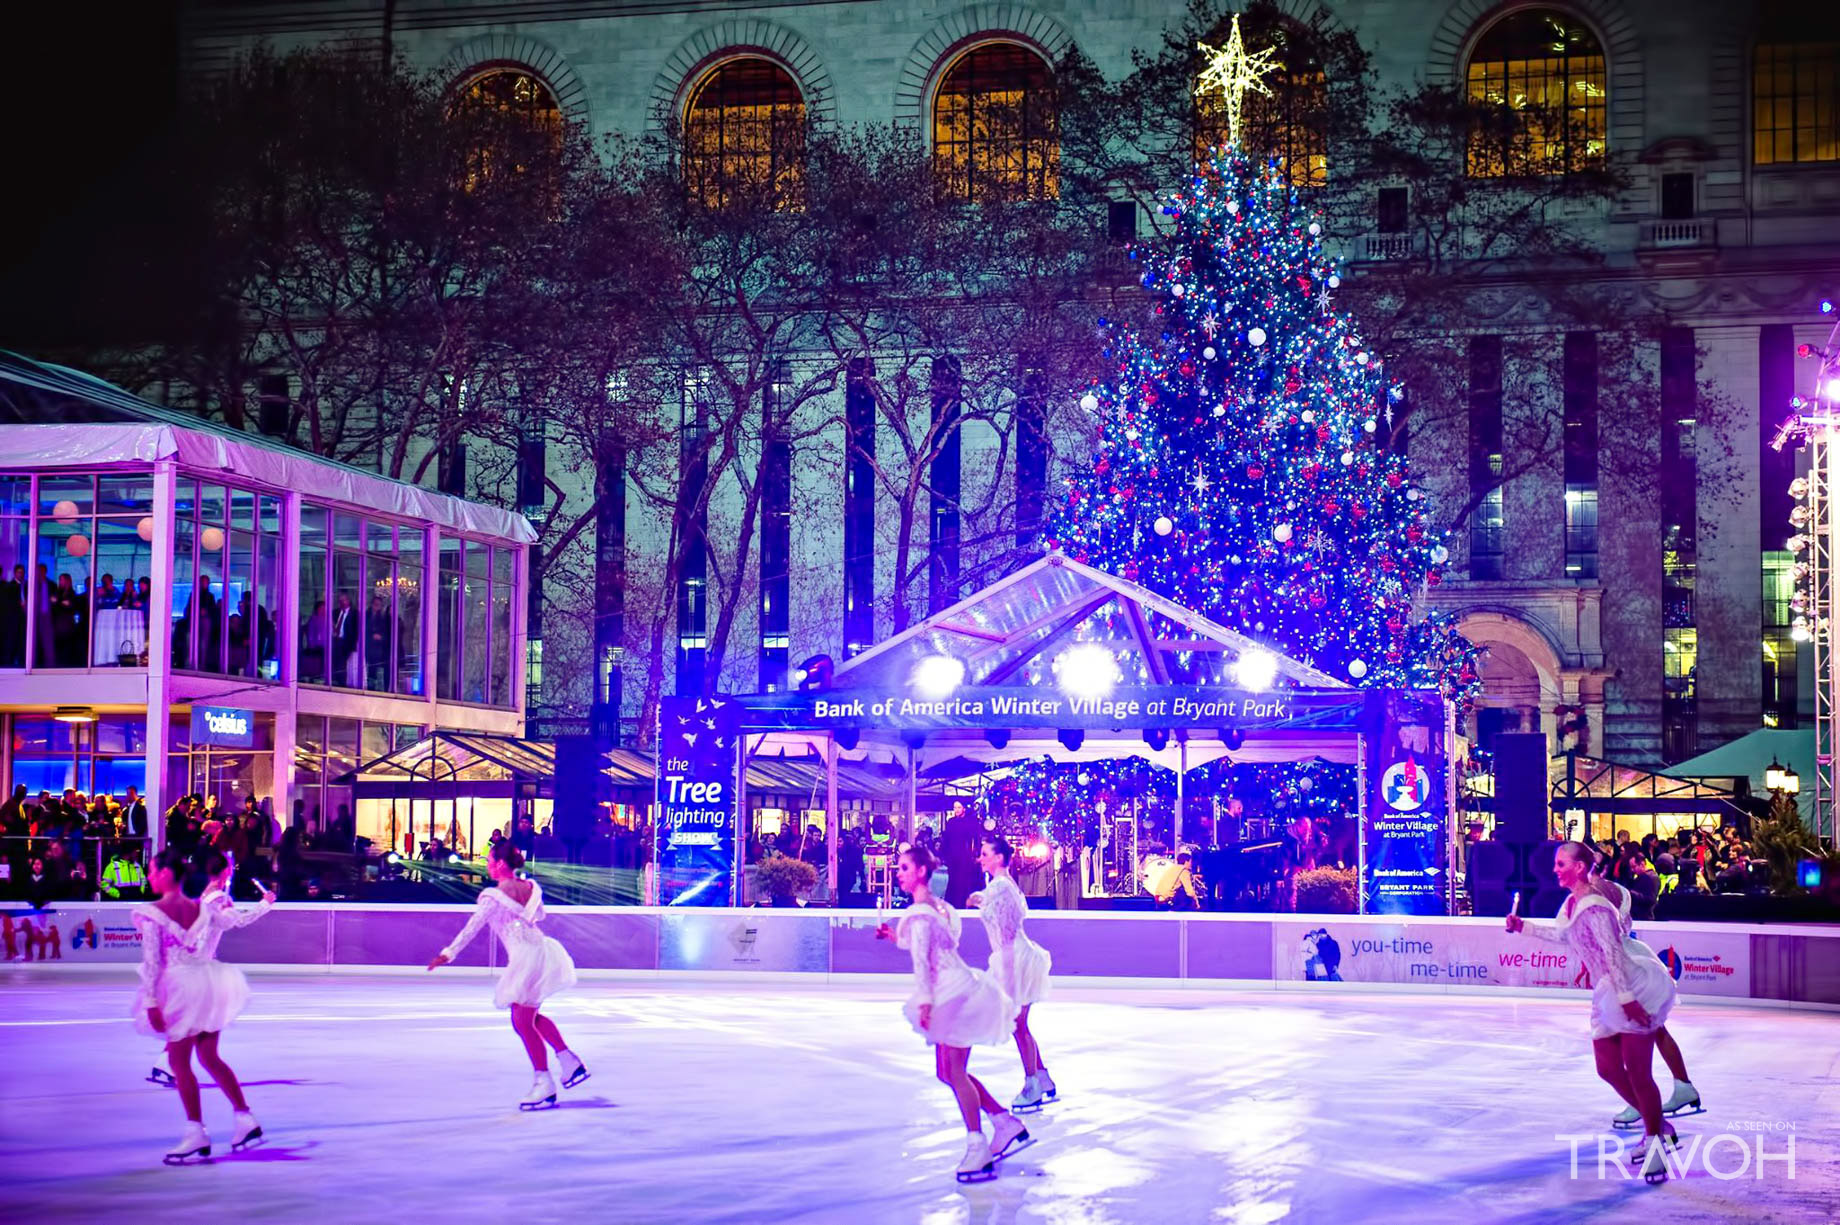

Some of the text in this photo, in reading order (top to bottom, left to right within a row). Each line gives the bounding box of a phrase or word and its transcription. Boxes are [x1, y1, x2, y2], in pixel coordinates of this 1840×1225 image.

[815, 696, 1286, 720] Bank of America Winter Village at Bryant Park
[667, 756, 689, 771] the
[665, 775, 722, 803] Tree
[666, 806, 725, 828] lighting
[1374, 821, 1439, 832] Winter Village
[674, 833, 715, 843] SHOW
[1391, 831, 1411, 840] Bryant
[104, 933, 133, 941] Winter
[1351, 937, 1433, 957] you-time
[1499, 951, 1567, 969] we-time
[1410, 961, 1488, 979] me-time
[1684, 963, 1734, 976] Winter Village
